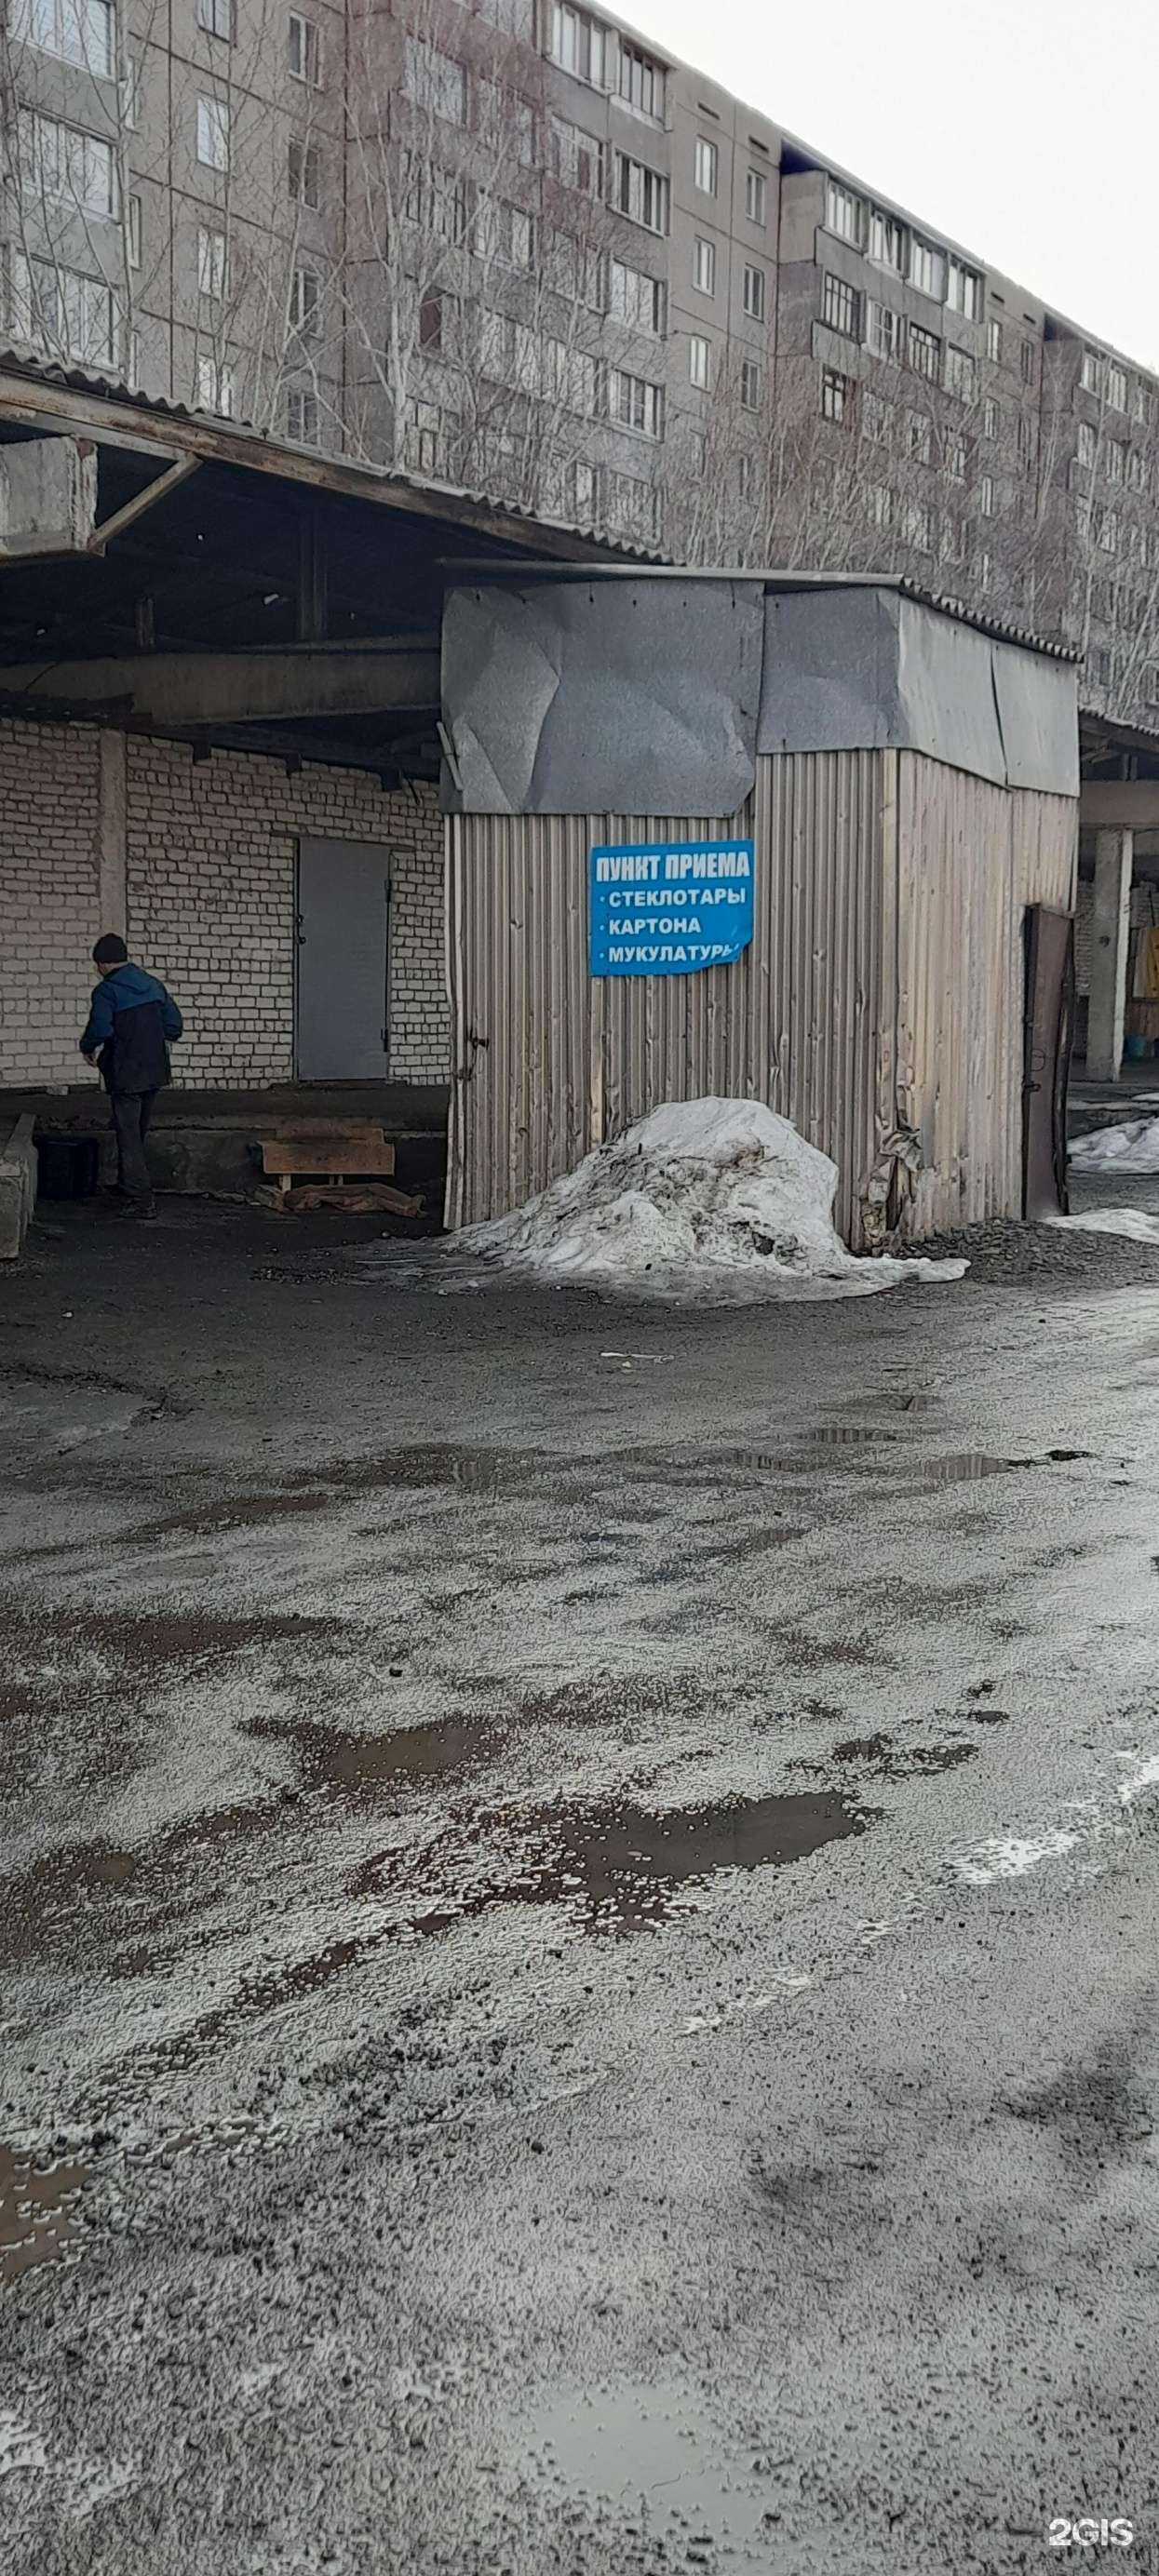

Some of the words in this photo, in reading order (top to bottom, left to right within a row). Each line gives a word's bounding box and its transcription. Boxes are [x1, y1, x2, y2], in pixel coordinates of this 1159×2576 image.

[596, 855, 661, 882] ПУНКТ
[665, 852, 750, 879] ПРИЕМА
[609, 888, 746, 907] СТЕКЛОТАРЫ
[609, 918, 702, 935] КАРТОНА
